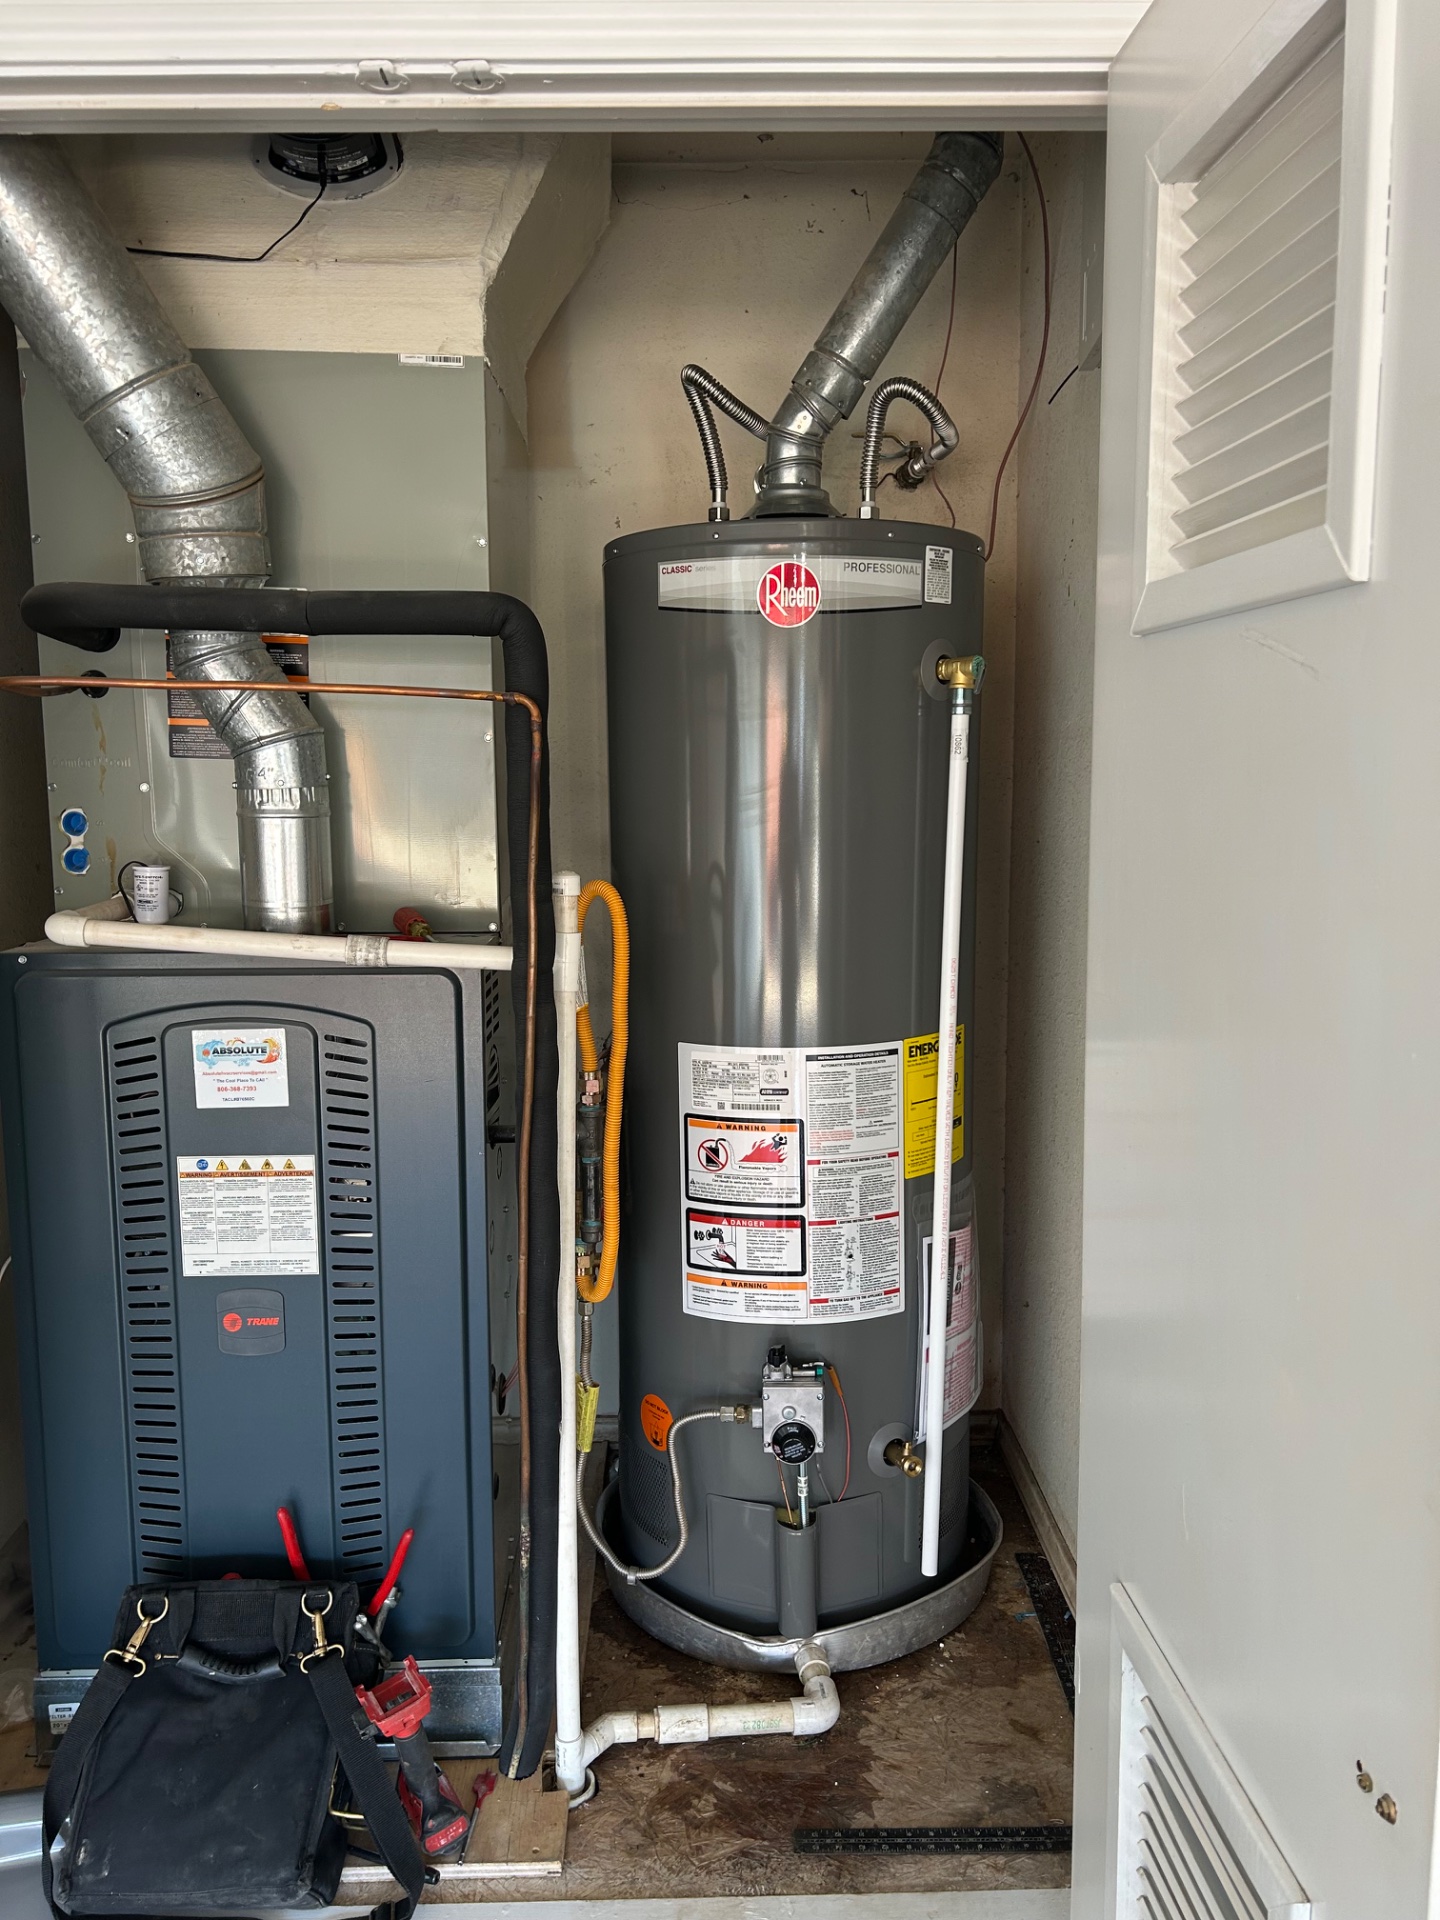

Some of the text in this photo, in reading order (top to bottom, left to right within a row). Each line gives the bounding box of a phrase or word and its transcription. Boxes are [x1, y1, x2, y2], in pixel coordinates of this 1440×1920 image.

[661, 565, 692, 575] CLASSIC
[843, 561, 920, 576] PROFESSIONAL
[766, 563, 817, 617] Rheem
[211, 1046, 268, 1055] ABSOLUTE
[730, 1219, 765, 1227] DANGER
[730, 1281, 768, 1289] WARNING
[247, 1317, 279, 1326] TRANE
